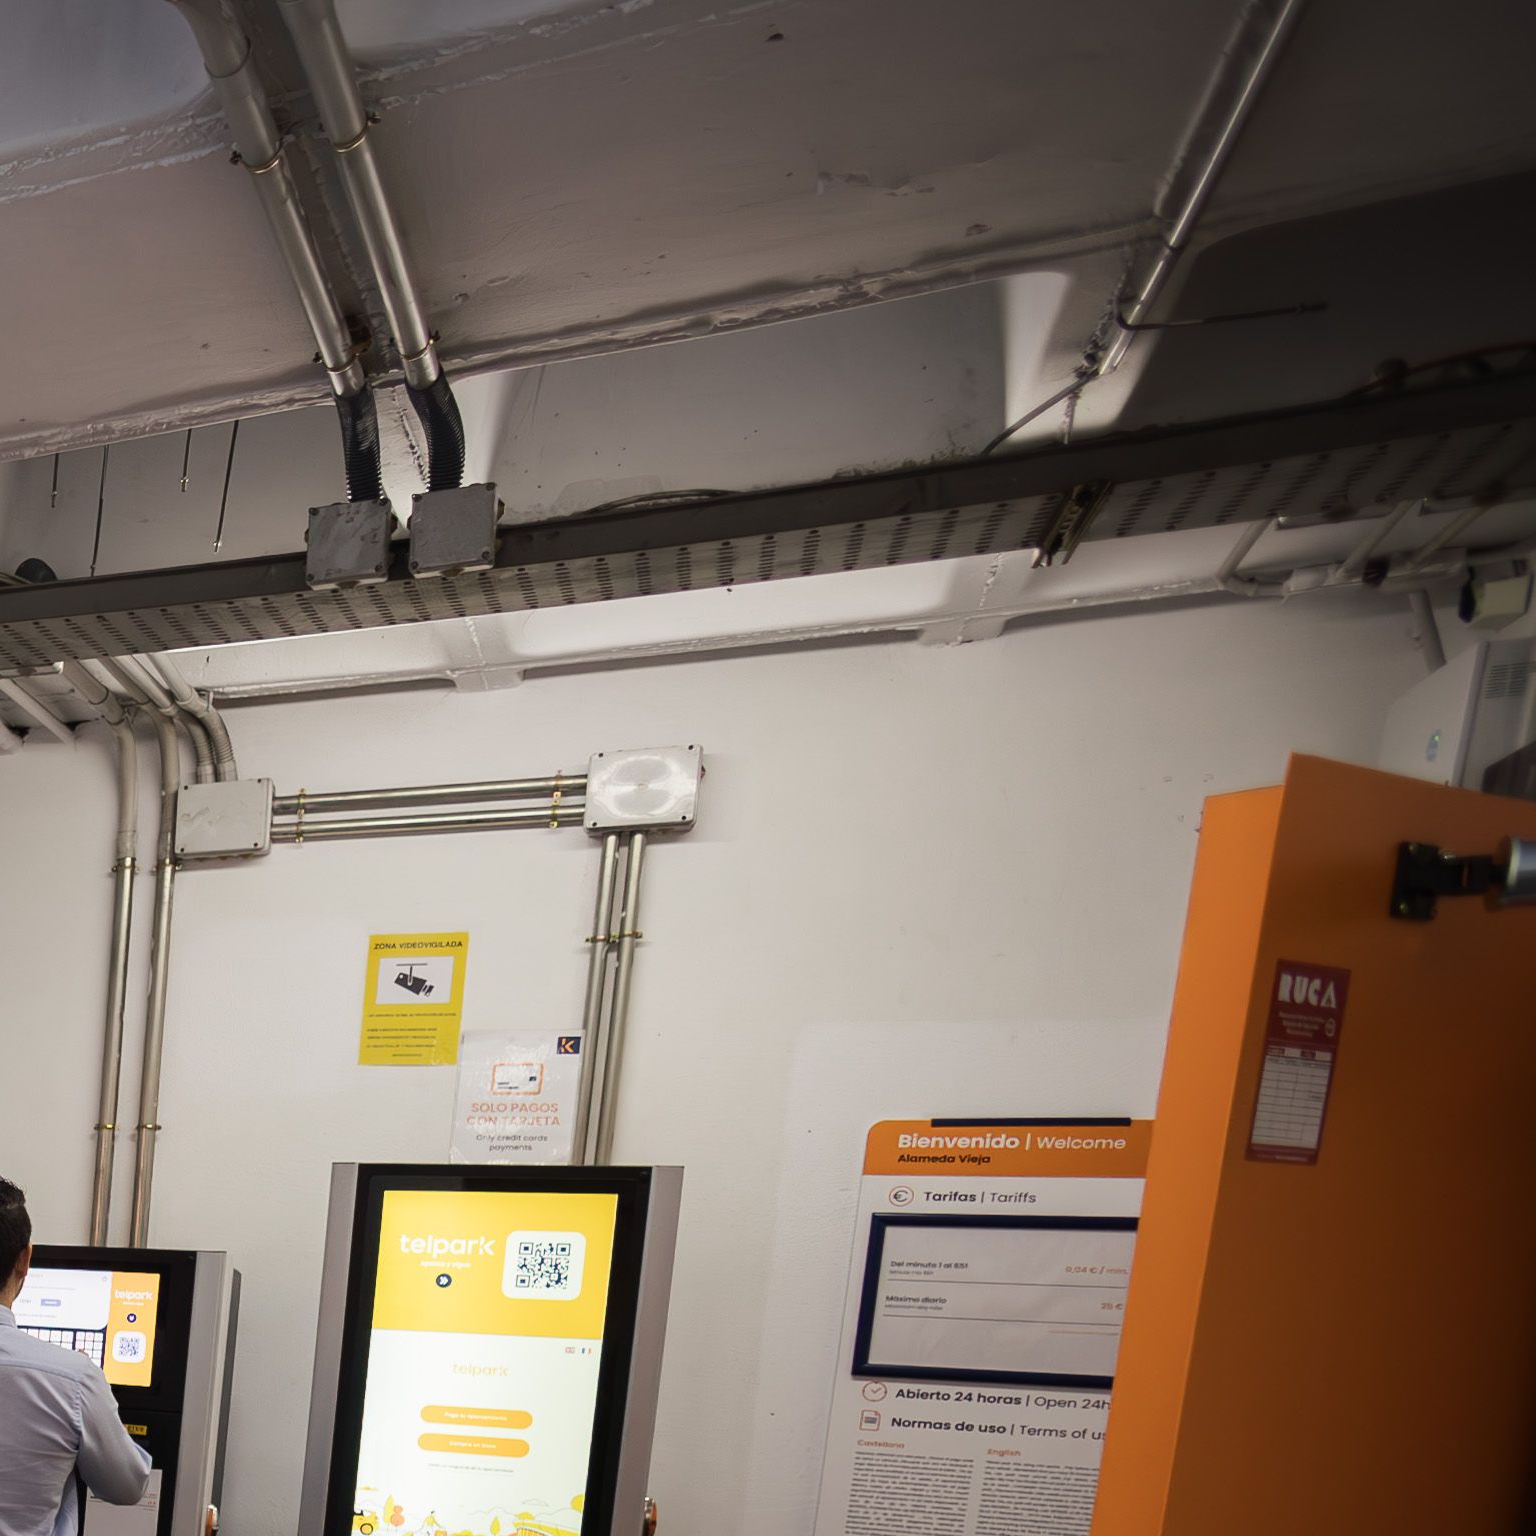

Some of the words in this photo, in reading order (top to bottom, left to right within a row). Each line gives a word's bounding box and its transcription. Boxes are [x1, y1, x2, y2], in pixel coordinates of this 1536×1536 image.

[399, 940, 463, 949] VIDEOVIGILADA
[1278, 973, 1337, 1009] RUCA
[471, 1103, 507, 1113] SOLO
[510, 1103, 559, 1113] PAGOS
[466, 1116, 498, 1126] CON
[476, 1134, 495, 1142] Only
[523, 1134, 548, 1142] cards
[897, 1133, 1020, 1150] Bienvenido
[1036, 1136, 1127, 1150] Welcome
[489, 1144, 533, 1152] payments
[897, 1153, 956, 1164] Alameda
[958, 1154, 991, 1166] Vieja
[924, 1191, 977, 1202] Tarifas
[989, 1191, 1037, 1203] Tariffs
[400, 1234, 496, 1259] telpark
[114, 1289, 153, 1302] telpark
[452, 1363, 511, 1377] telpark
[895, 1388, 951, 1402] Abierto
[954, 1391, 973, 1402] 24
[977, 1393, 1022, 1405] horas
[1034, 1396, 1077, 1410] Open
[891, 1417, 951, 1431] Normas
[954, 1421, 974, 1432] de
[978, 1423, 1007, 1434] uso
[1019, 1424, 1067, 1438] Terms
[1071, 1427, 1088, 1439] of
[987, 1448, 1021, 1457] English
